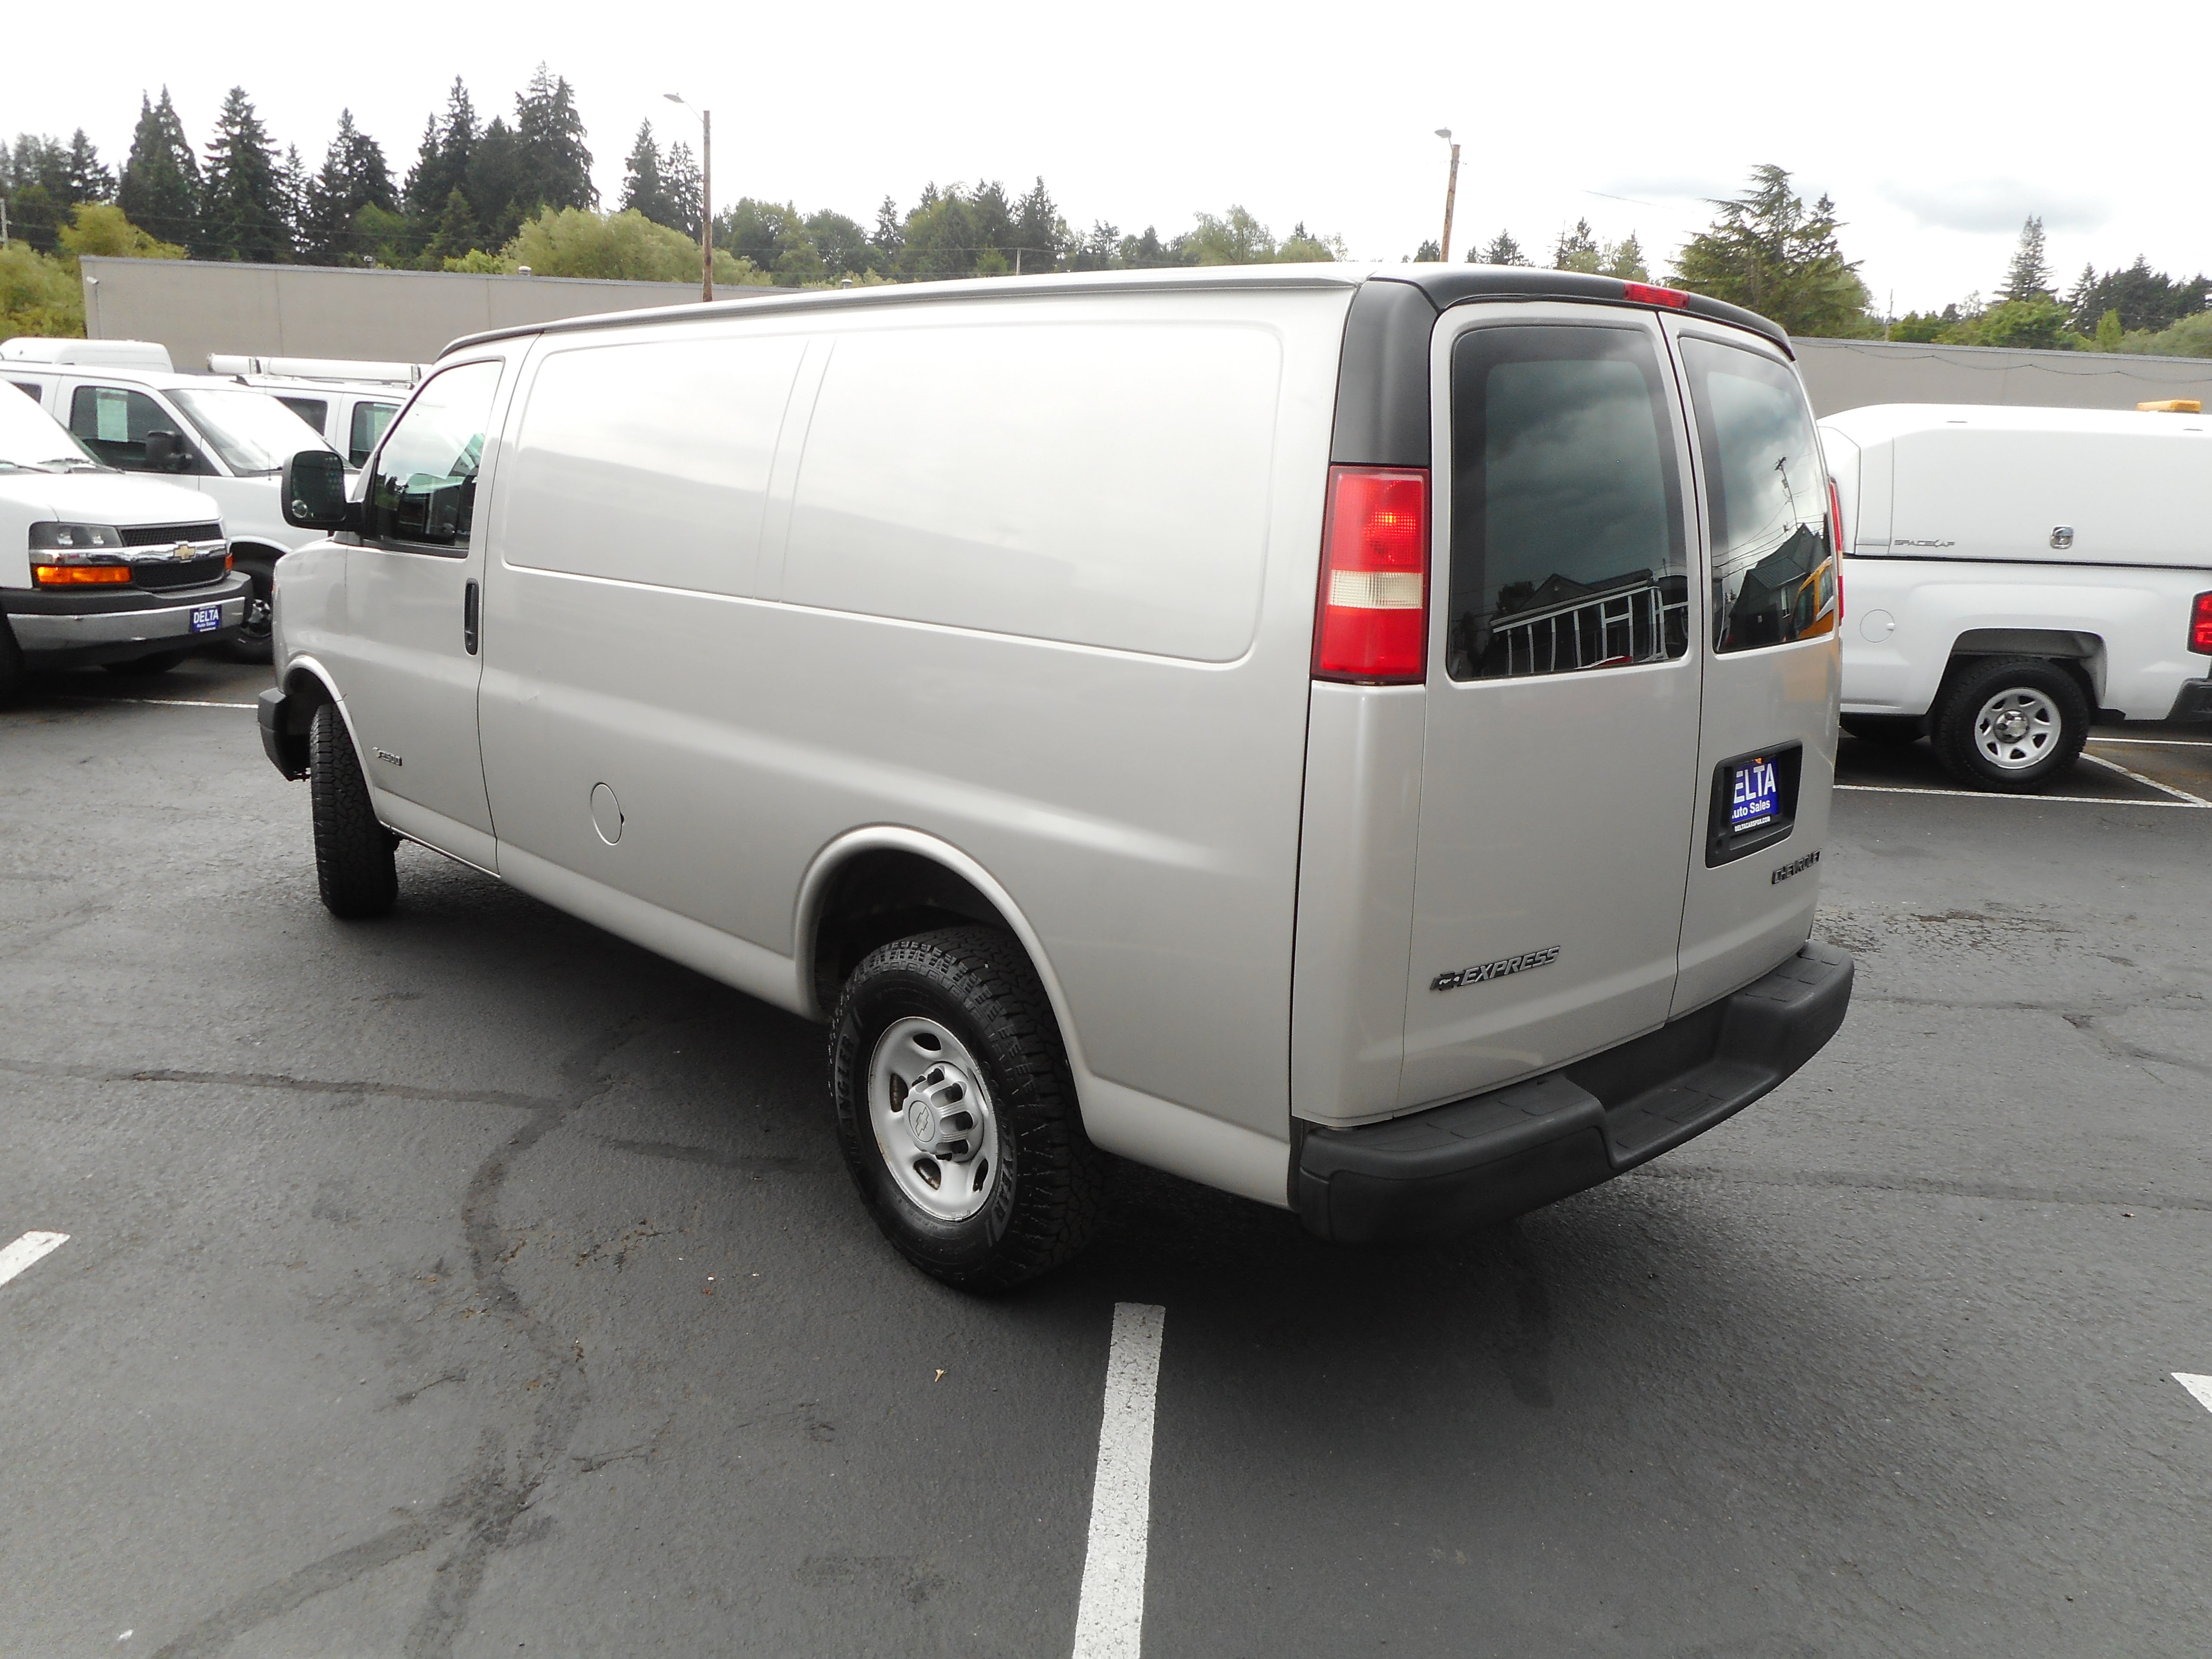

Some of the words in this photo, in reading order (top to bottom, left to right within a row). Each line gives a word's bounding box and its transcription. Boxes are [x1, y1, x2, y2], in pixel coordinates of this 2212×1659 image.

[193, 609, 219, 624] DELTA
[1733, 763, 1776, 804] ELTA
[1732, 806, 1748, 819] uto
[1749, 800, 1771, 814] Sales
[1461, 945, 1561, 986] EXPRESS
